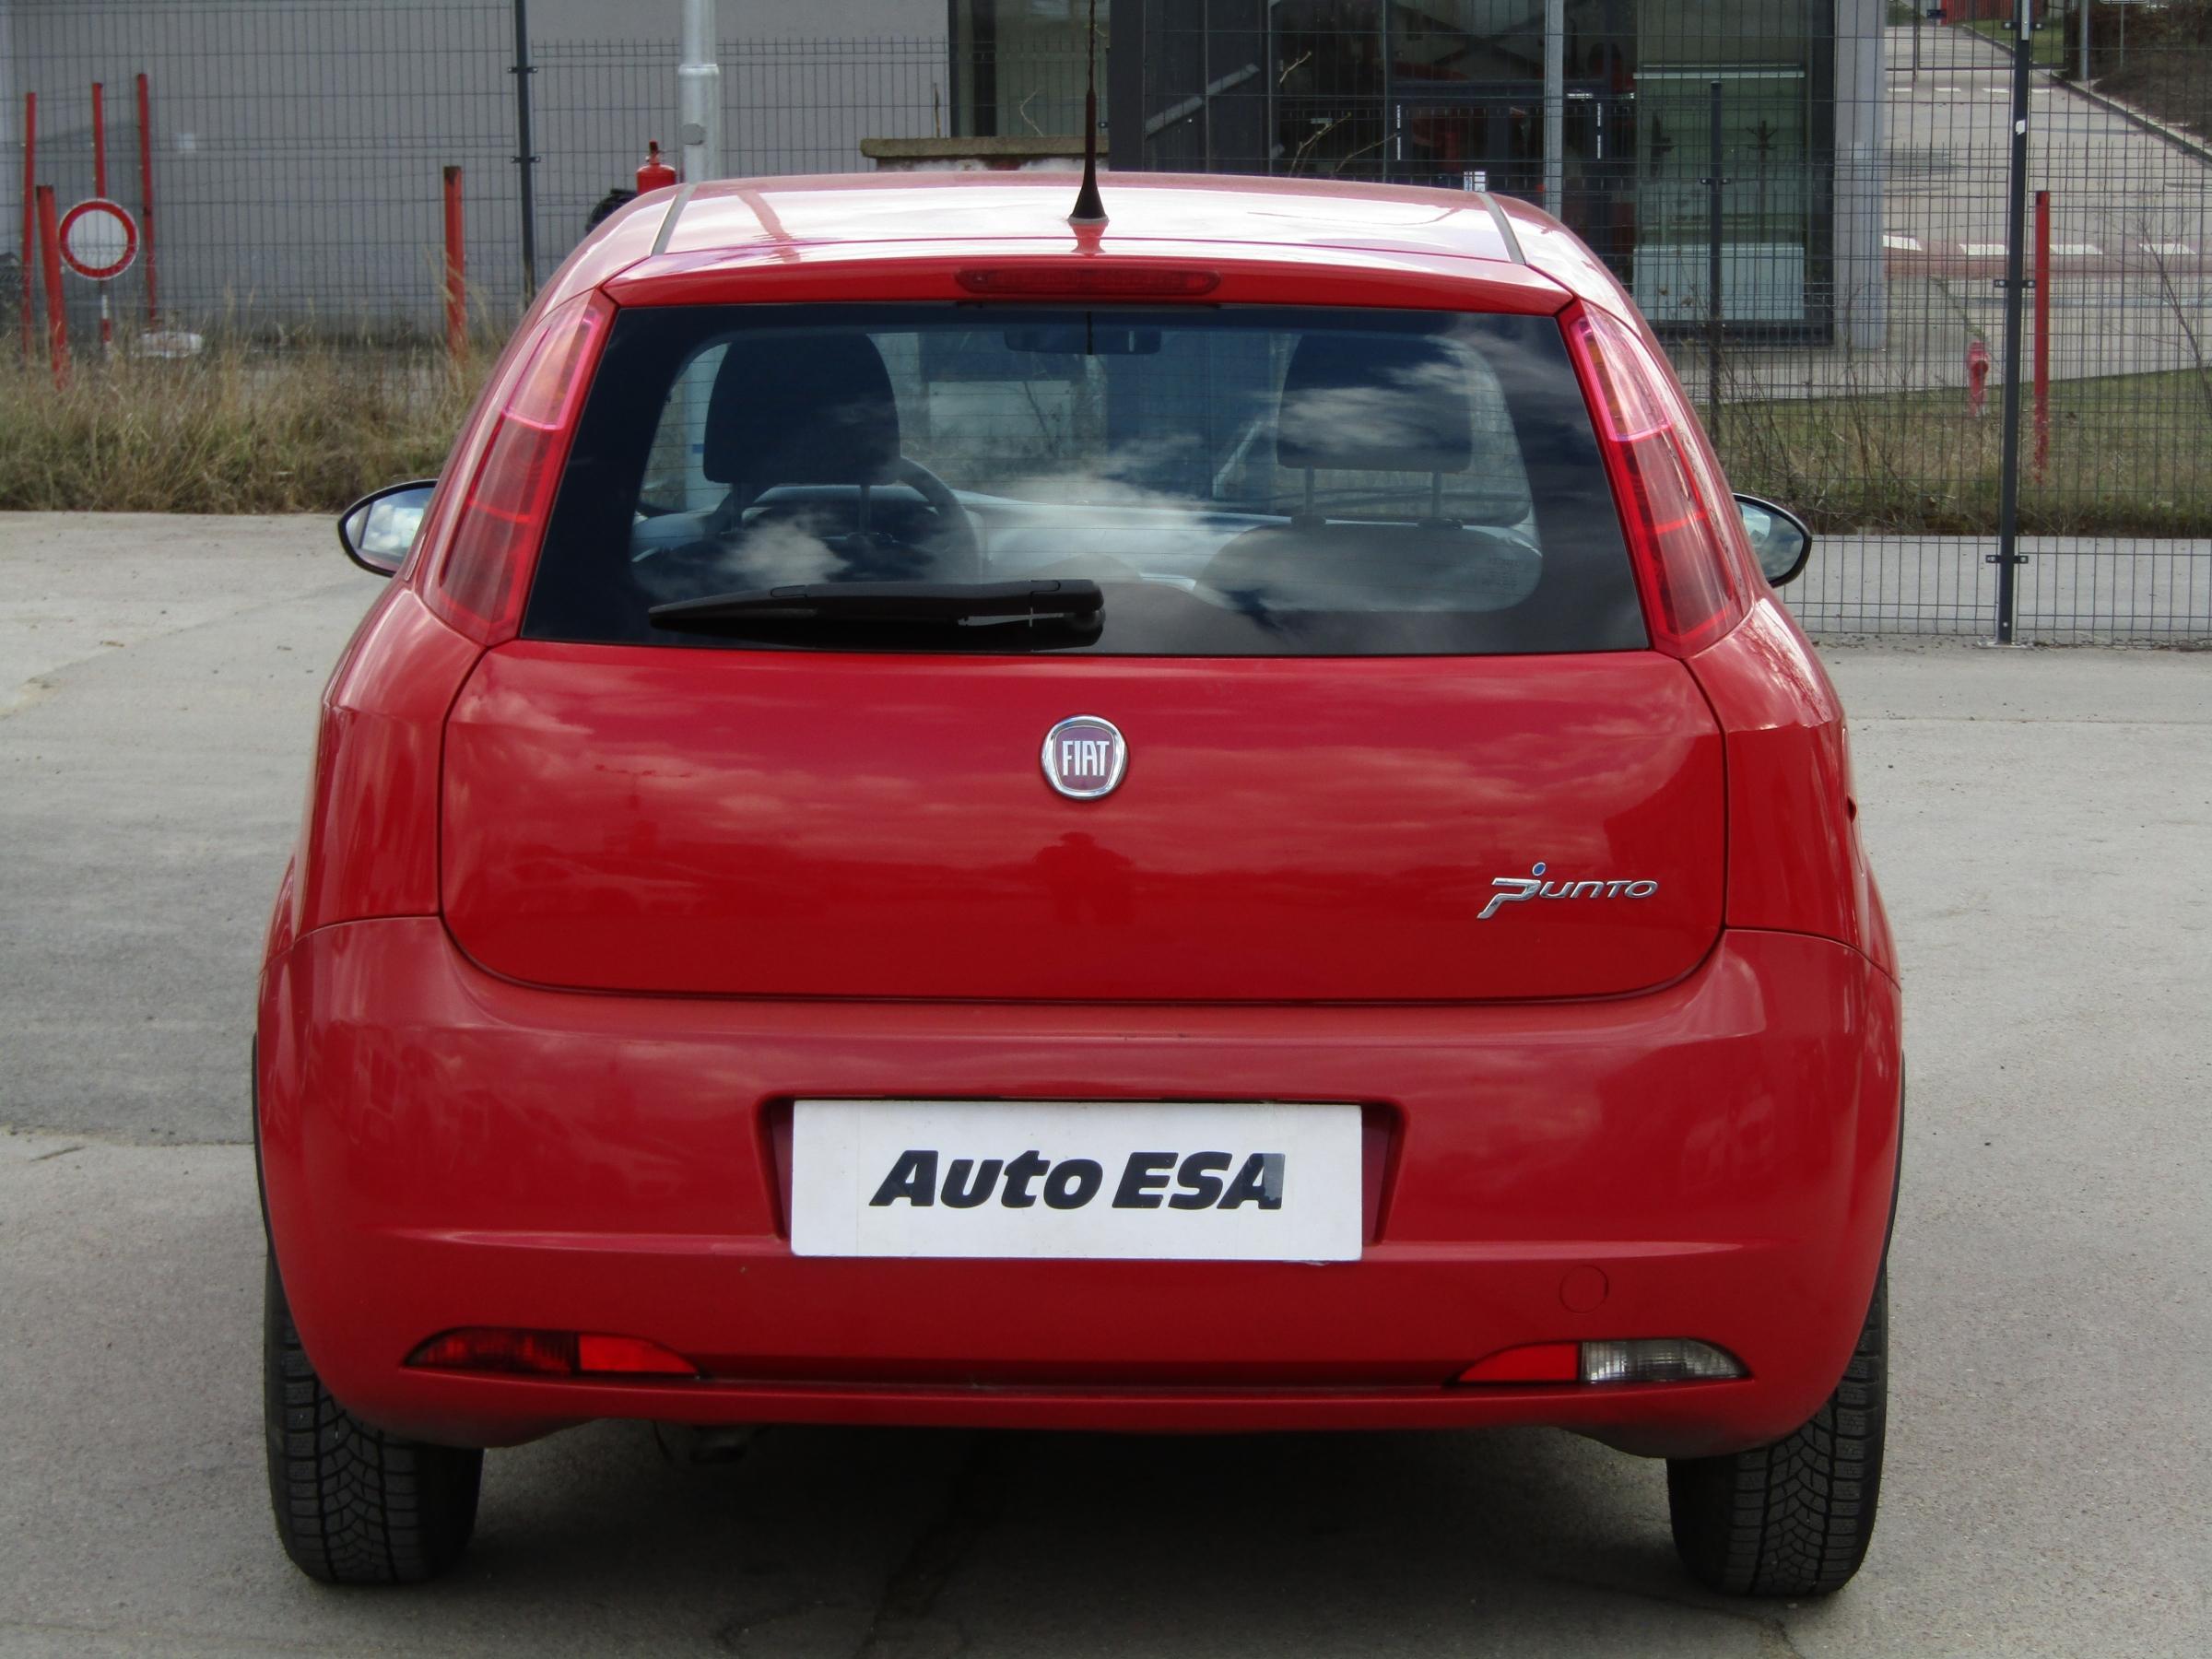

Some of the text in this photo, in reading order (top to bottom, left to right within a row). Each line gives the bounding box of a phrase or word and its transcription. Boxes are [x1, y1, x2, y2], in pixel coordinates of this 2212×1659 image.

[1062, 740, 1110, 776] FIAT
[868, 1149, 1286, 1210] Auto ESA
